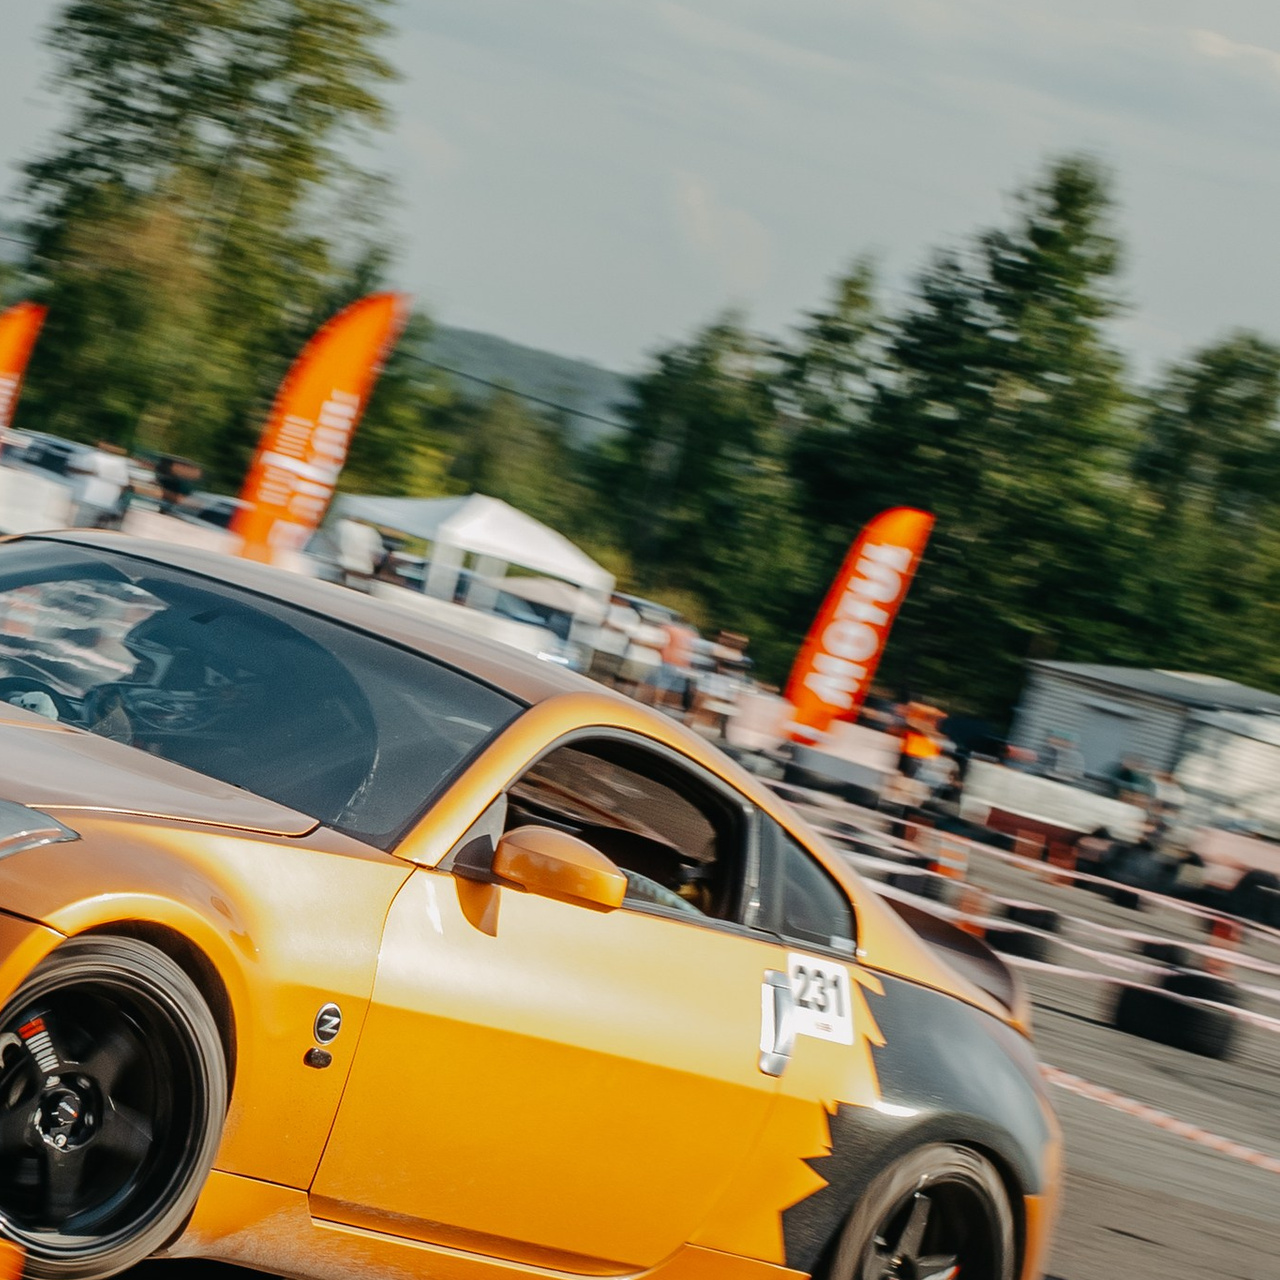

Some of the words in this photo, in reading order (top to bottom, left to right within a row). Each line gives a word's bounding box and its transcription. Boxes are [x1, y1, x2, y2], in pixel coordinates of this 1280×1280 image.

[803, 543, 913, 710] MOTUL
[794, 964, 845, 1018] 231
[318, 1014, 341, 1035] Z
